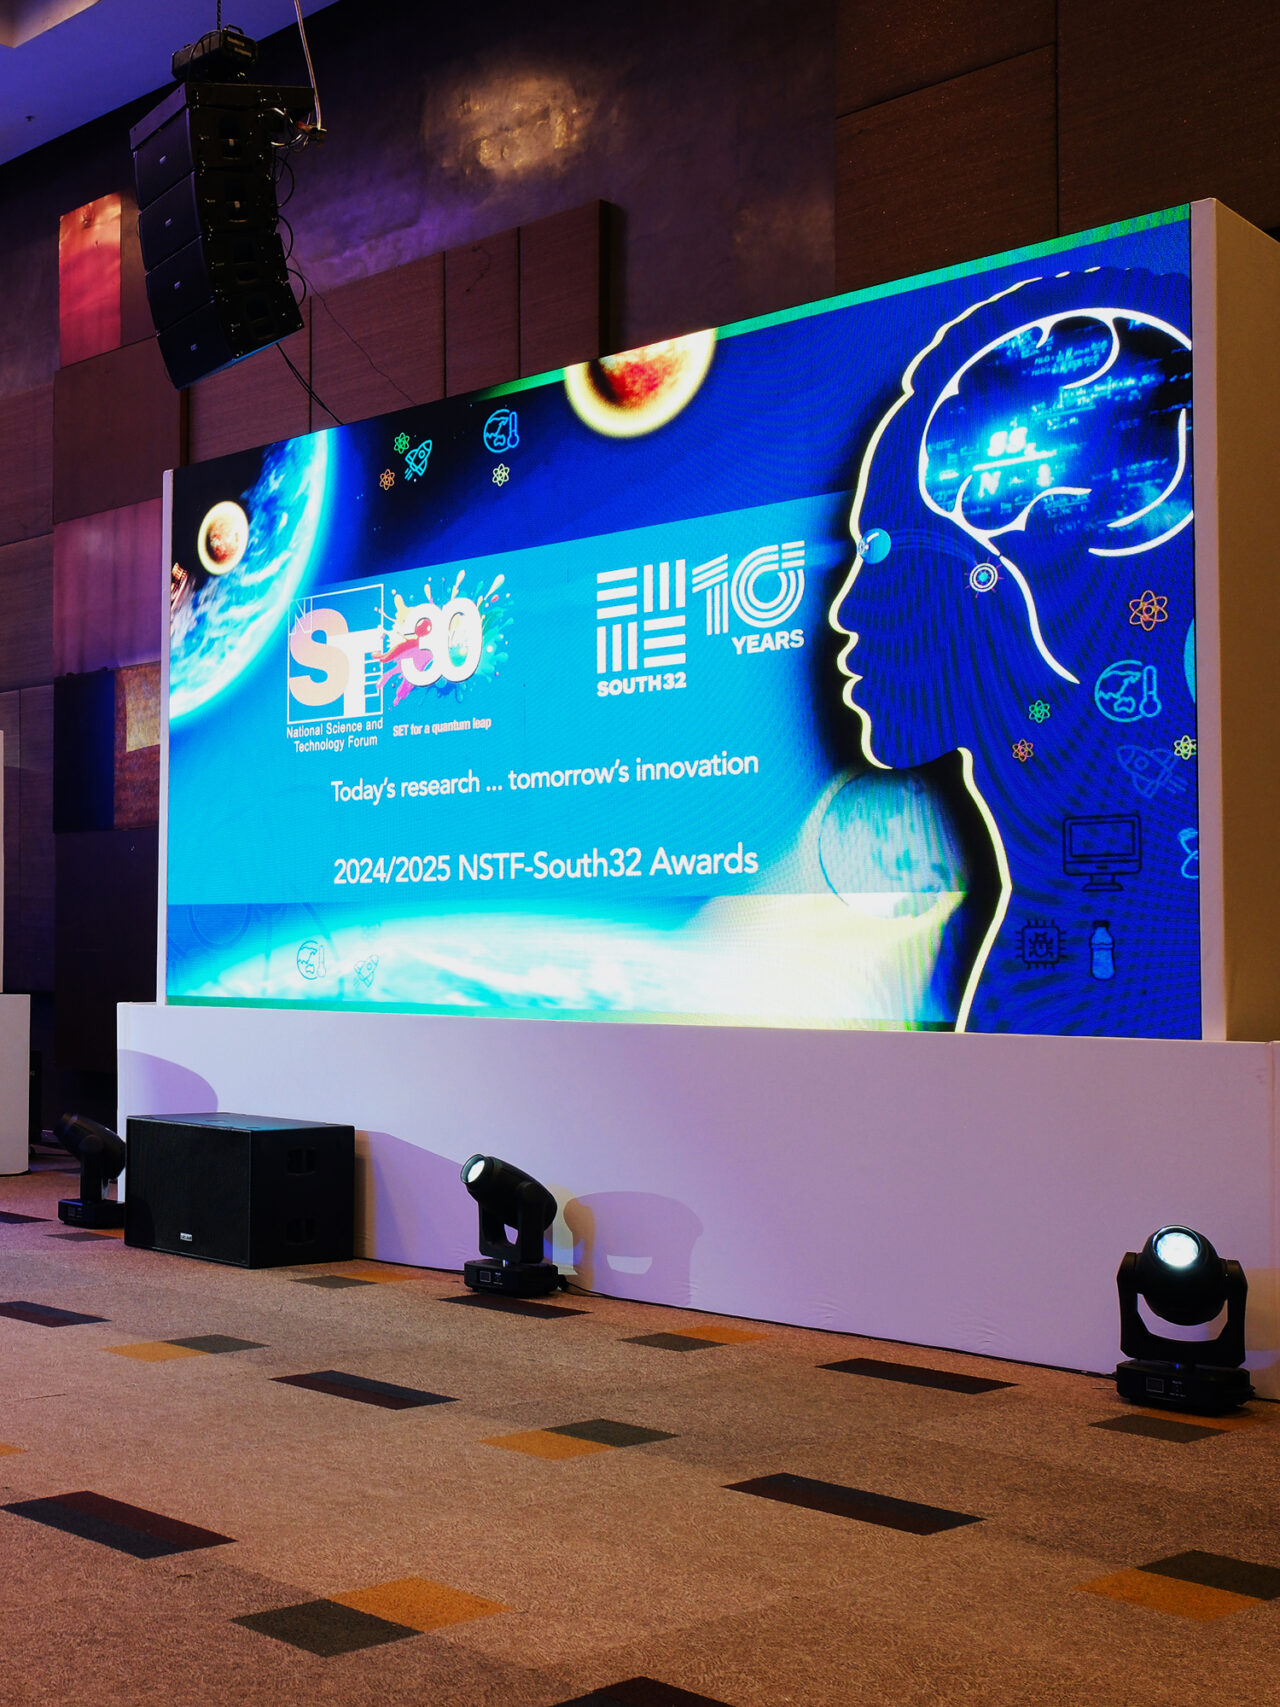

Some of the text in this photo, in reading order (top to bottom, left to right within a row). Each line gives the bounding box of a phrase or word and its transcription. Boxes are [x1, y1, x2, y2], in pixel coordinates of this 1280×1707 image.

[691, 540, 805, 636] 10
[400, 597, 483, 687] 30
[731, 629, 805, 655] YEARS
[596, 672, 687, 697] SOUTH32
[286, 717, 384, 739] National Science and
[392, 717, 492, 737] SET for a quantum leap
[294, 734, 378, 752] Technology Forum
[401, 769, 480, 797] research
[636, 751, 759, 781] innovation
[333, 841, 759, 885] 2024/2025 NSTF-South32 Awards
